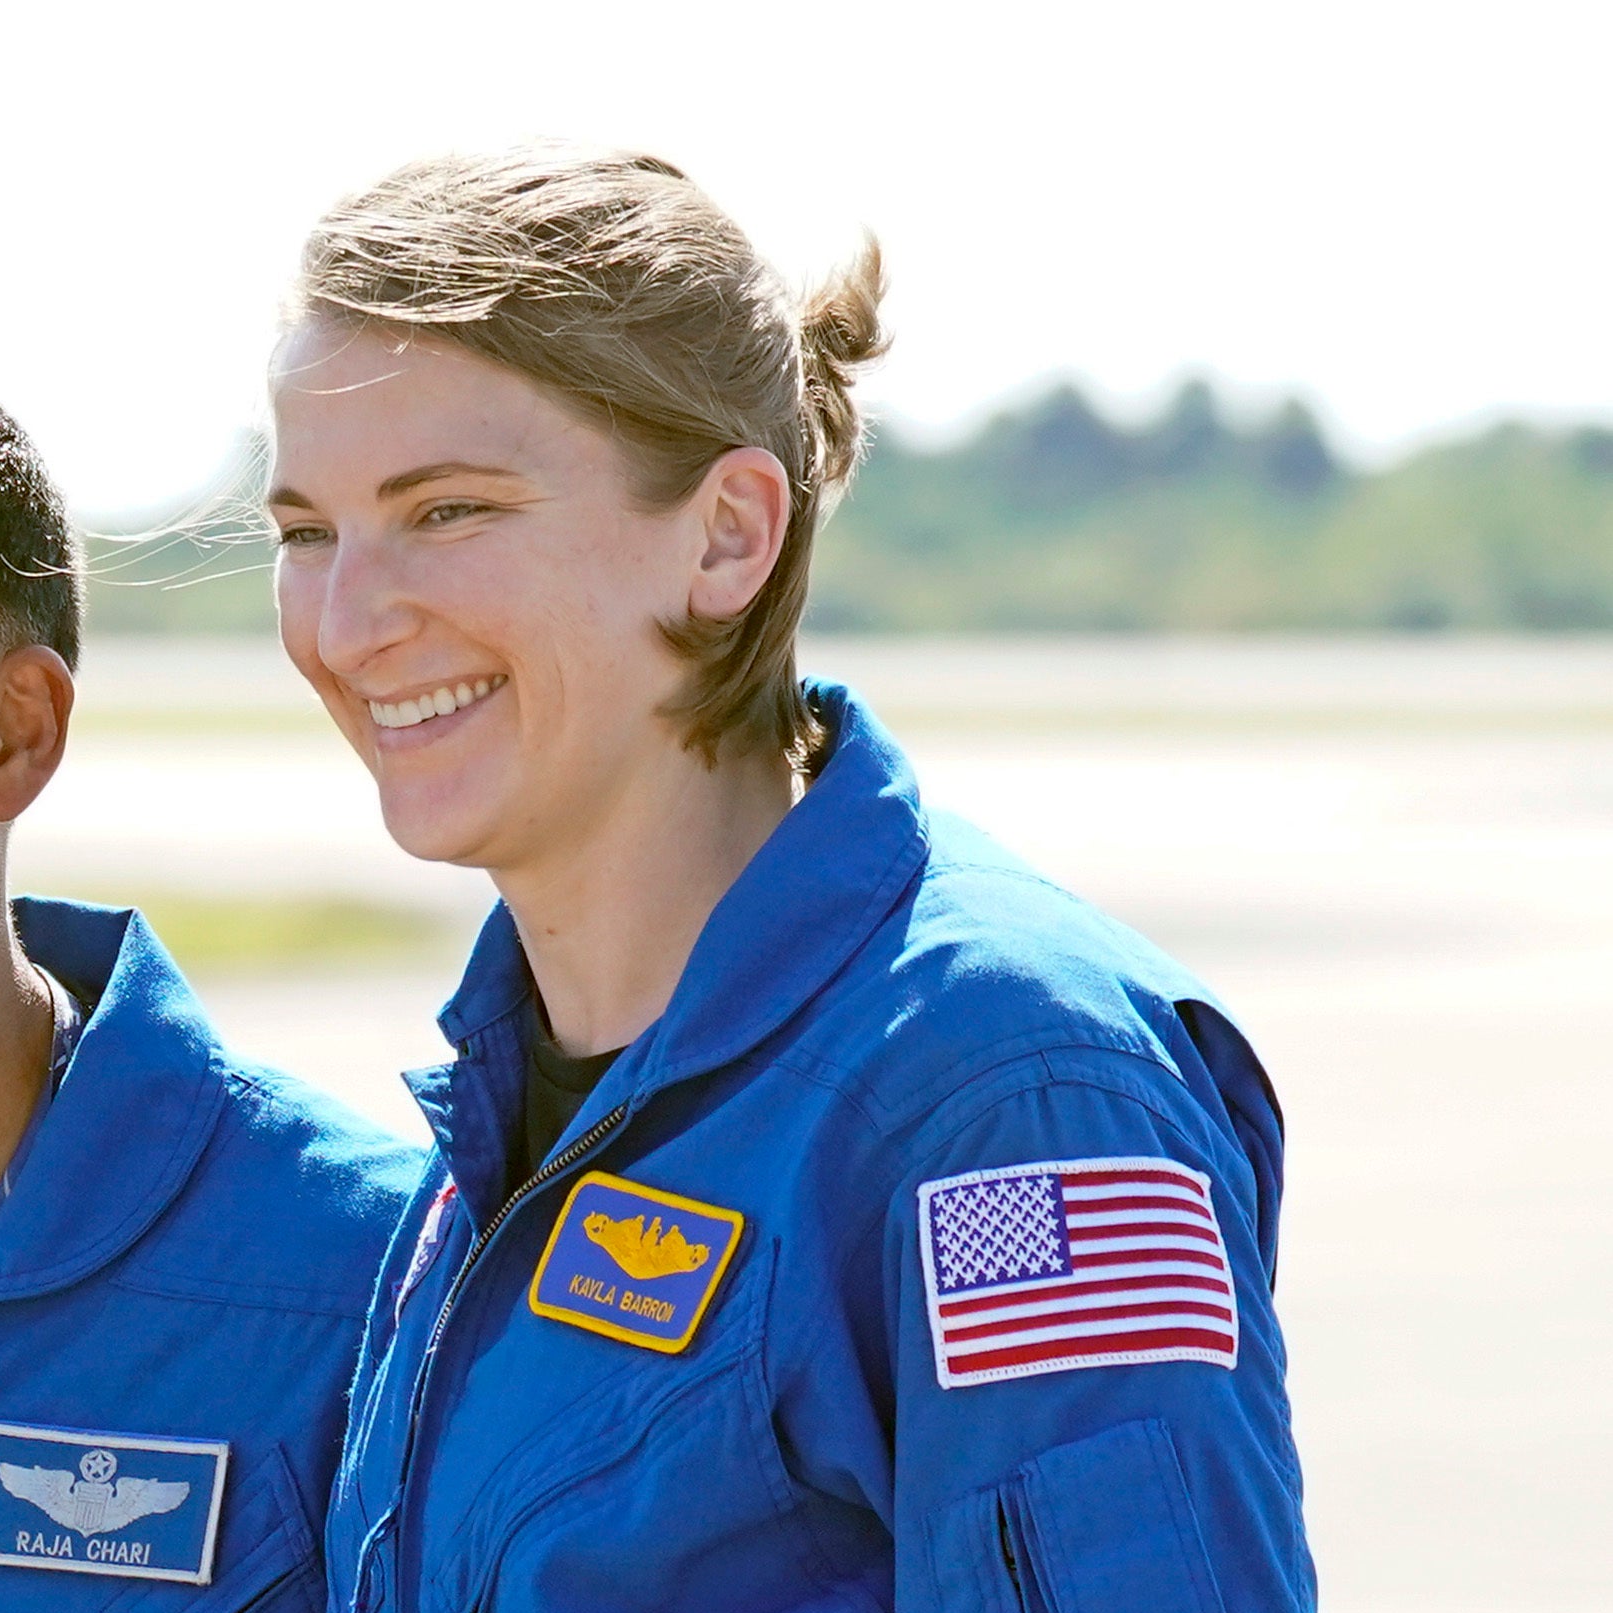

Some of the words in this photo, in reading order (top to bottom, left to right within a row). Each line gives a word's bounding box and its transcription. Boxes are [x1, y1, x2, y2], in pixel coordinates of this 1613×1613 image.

[570, 1273, 616, 1306] KAYLA
[619, 1291, 675, 1323] BARRON
[16, 1531, 74, 1558] RAJA
[87, 1537, 151, 1564] CHARI
